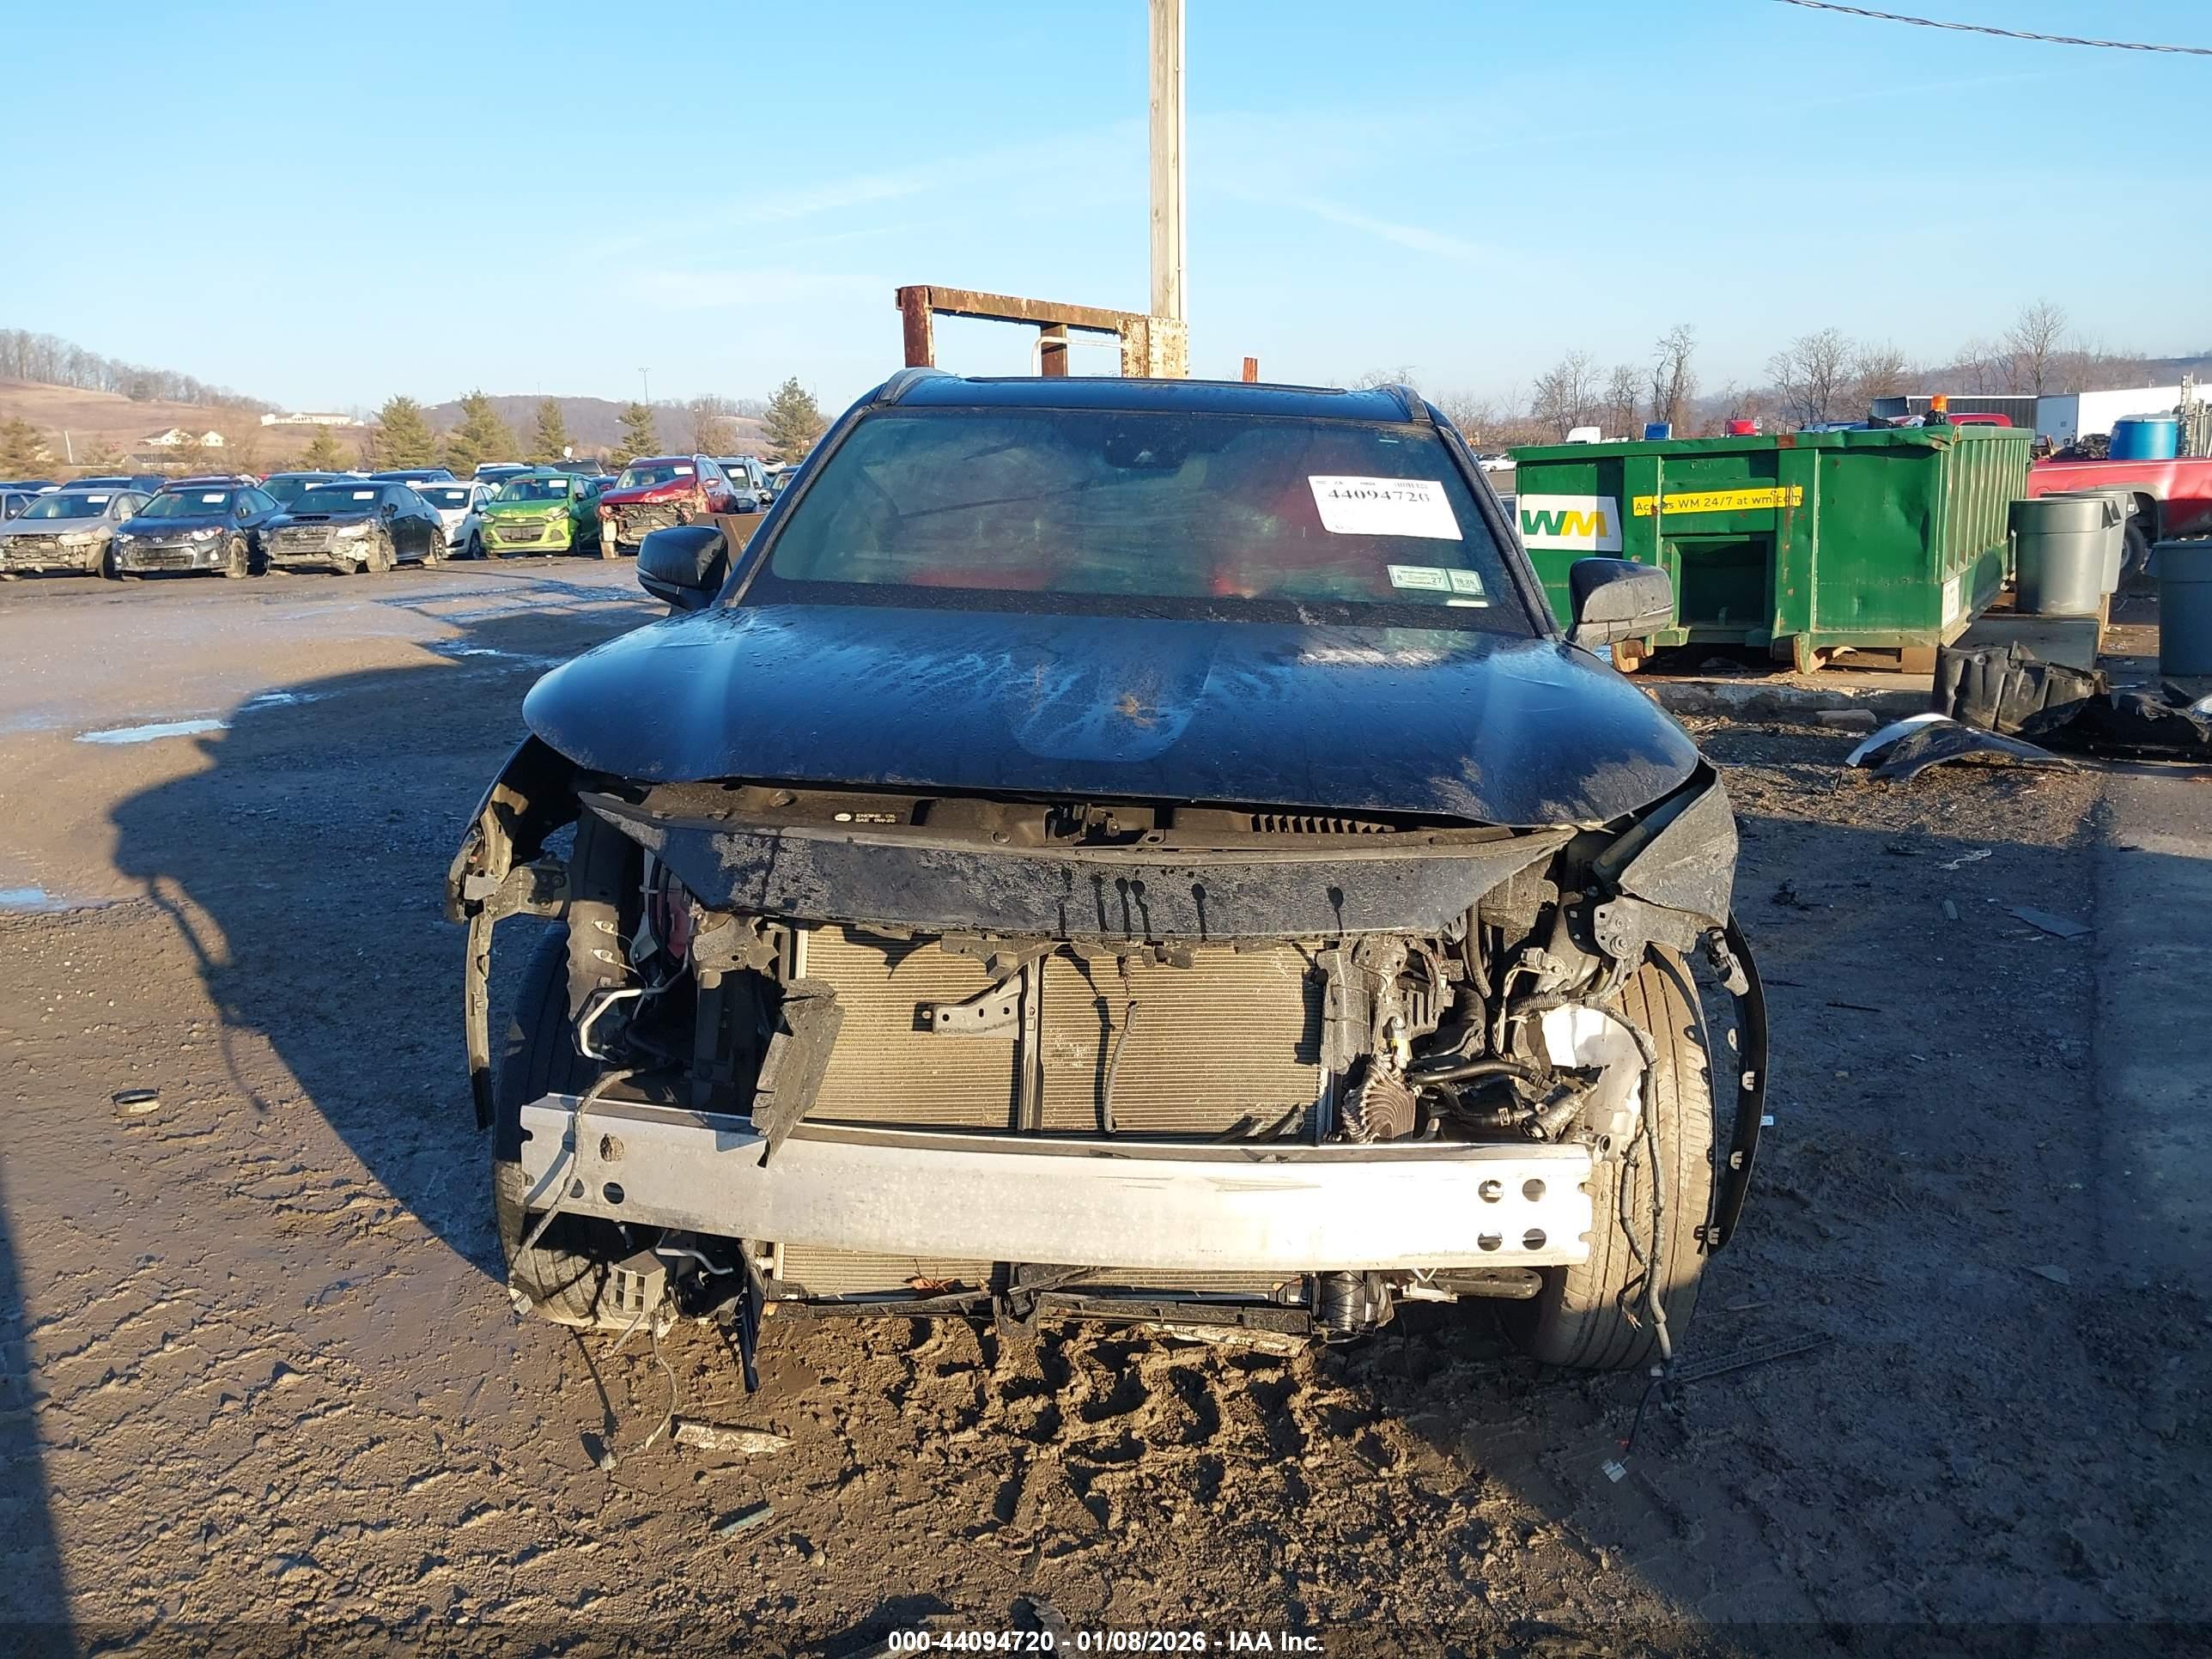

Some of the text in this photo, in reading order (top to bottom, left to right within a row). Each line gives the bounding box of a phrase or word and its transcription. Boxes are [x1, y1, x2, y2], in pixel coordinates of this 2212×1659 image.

[1328, 489, 1431, 502] 44094720
[1678, 499, 1699, 509] WM
[1704, 495, 1732, 508] 24/7
[1736, 495, 1748, 506] at
[1520, 509, 1608, 538] WM
